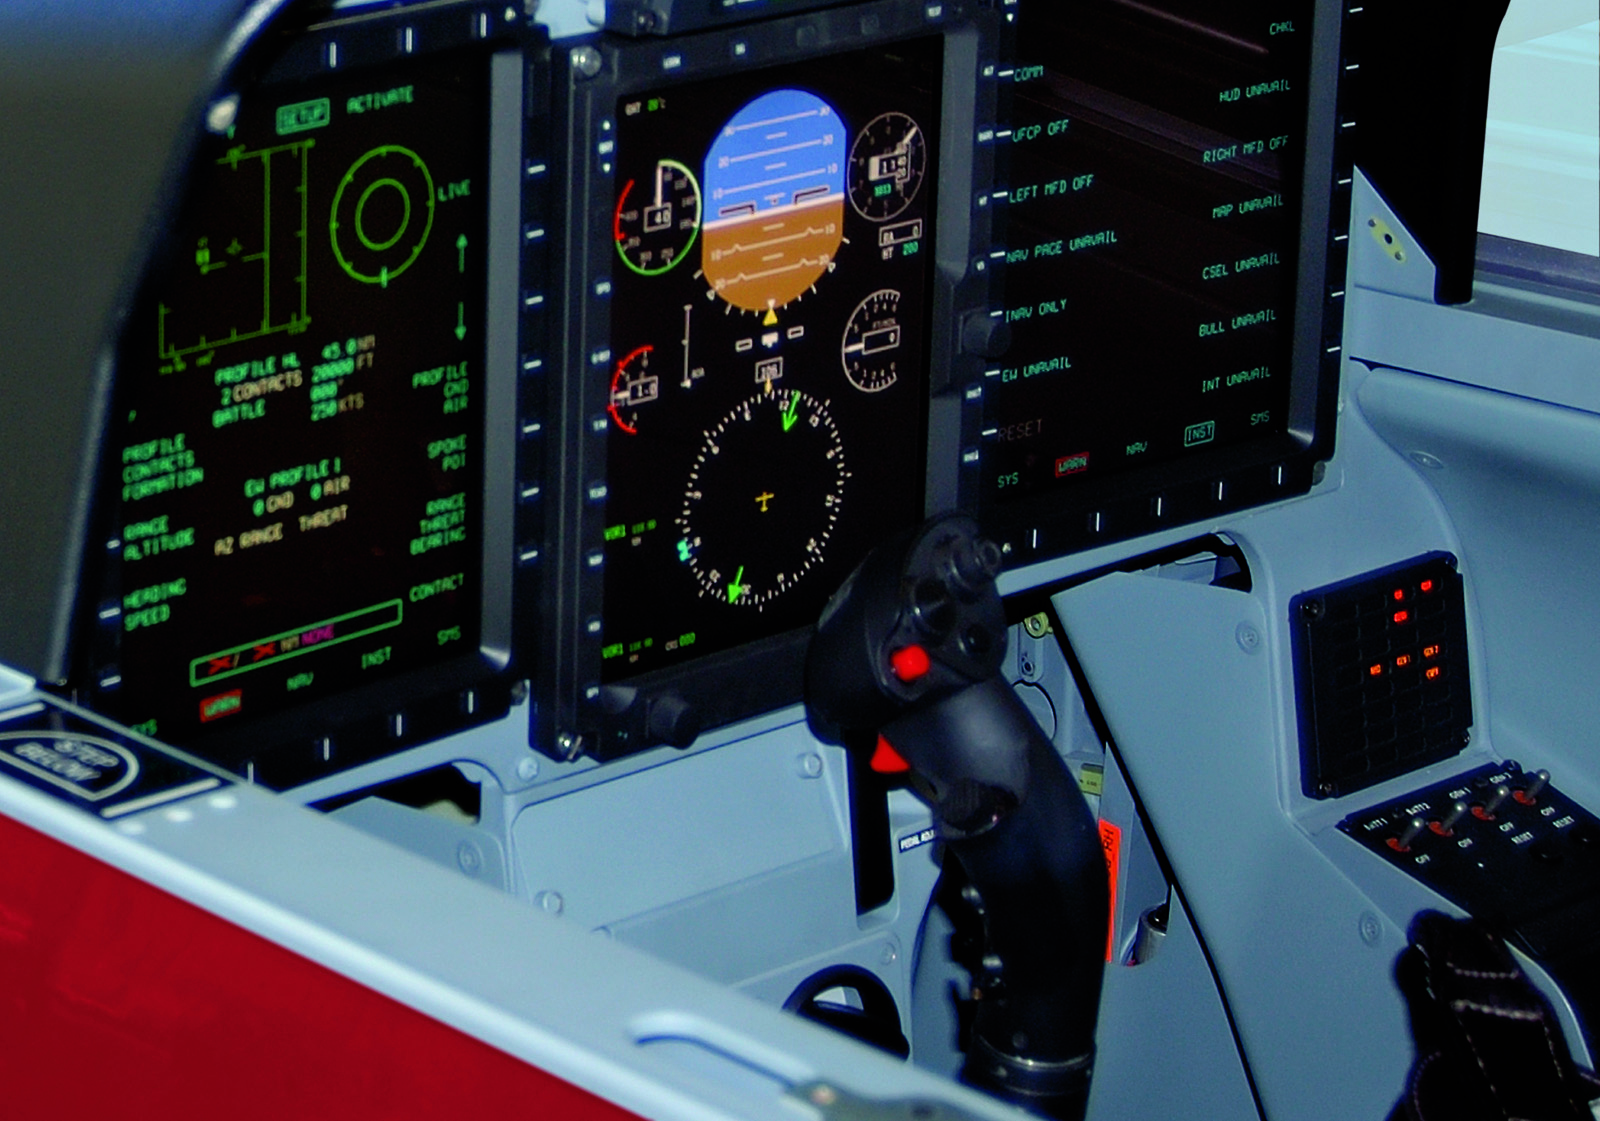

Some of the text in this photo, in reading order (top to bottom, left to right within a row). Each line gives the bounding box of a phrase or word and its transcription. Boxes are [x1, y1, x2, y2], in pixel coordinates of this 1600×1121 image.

[1014, 66, 1043, 81] COMM
[347, 85, 414, 113] ACTIVATE
[1219, 80, 1291, 102] HUD UNAVAIL
[1013, 120, 1069, 142] UFCP OFF
[1203, 135, 1288, 163] RIGHT MFD OFF
[828, 163, 837, 174] 10
[438, 180, 470, 201] LIVE
[1009, 174, 1094, 203] LEFT MFD OFF
[1213, 194, 1283, 218] MAP UNAVAIL
[1006, 231, 1117, 263] NAV PAGE UNAVAIL
[1202, 252, 1280, 279] CSEL UNAVAIL
[1039, 299, 1067, 316] ONLY
[1199, 309, 1276, 337] BULL UNAVAIL
[215, 356, 276, 385] PROFILE
[412, 361, 468, 388] PROFILE
[1002, 357, 1071, 382] EW UNAVAIL
[1203, 366, 1271, 393] INT UNAVAIL
[212, 399, 265, 428] BATTLE
[1250, 410, 1270, 426] SMS
[998, 419, 1043, 442] RESET
[1188, 425, 1212, 441] INST
[123, 433, 185, 464] PROFILE
[1126, 441, 1148, 455] NAV
[998, 472, 1019, 488] SYS
[426, 492, 466, 516] RANGE
[124, 515, 169, 541] RANGE
[239, 522, 283, 548] RANGE
[299, 504, 348, 531] THREAT
[420, 509, 465, 534] THREAT
[124, 527, 194, 561] ALTITUDE
[410, 573, 464, 602] CONTACT
[124, 604, 170, 631] SPEED
